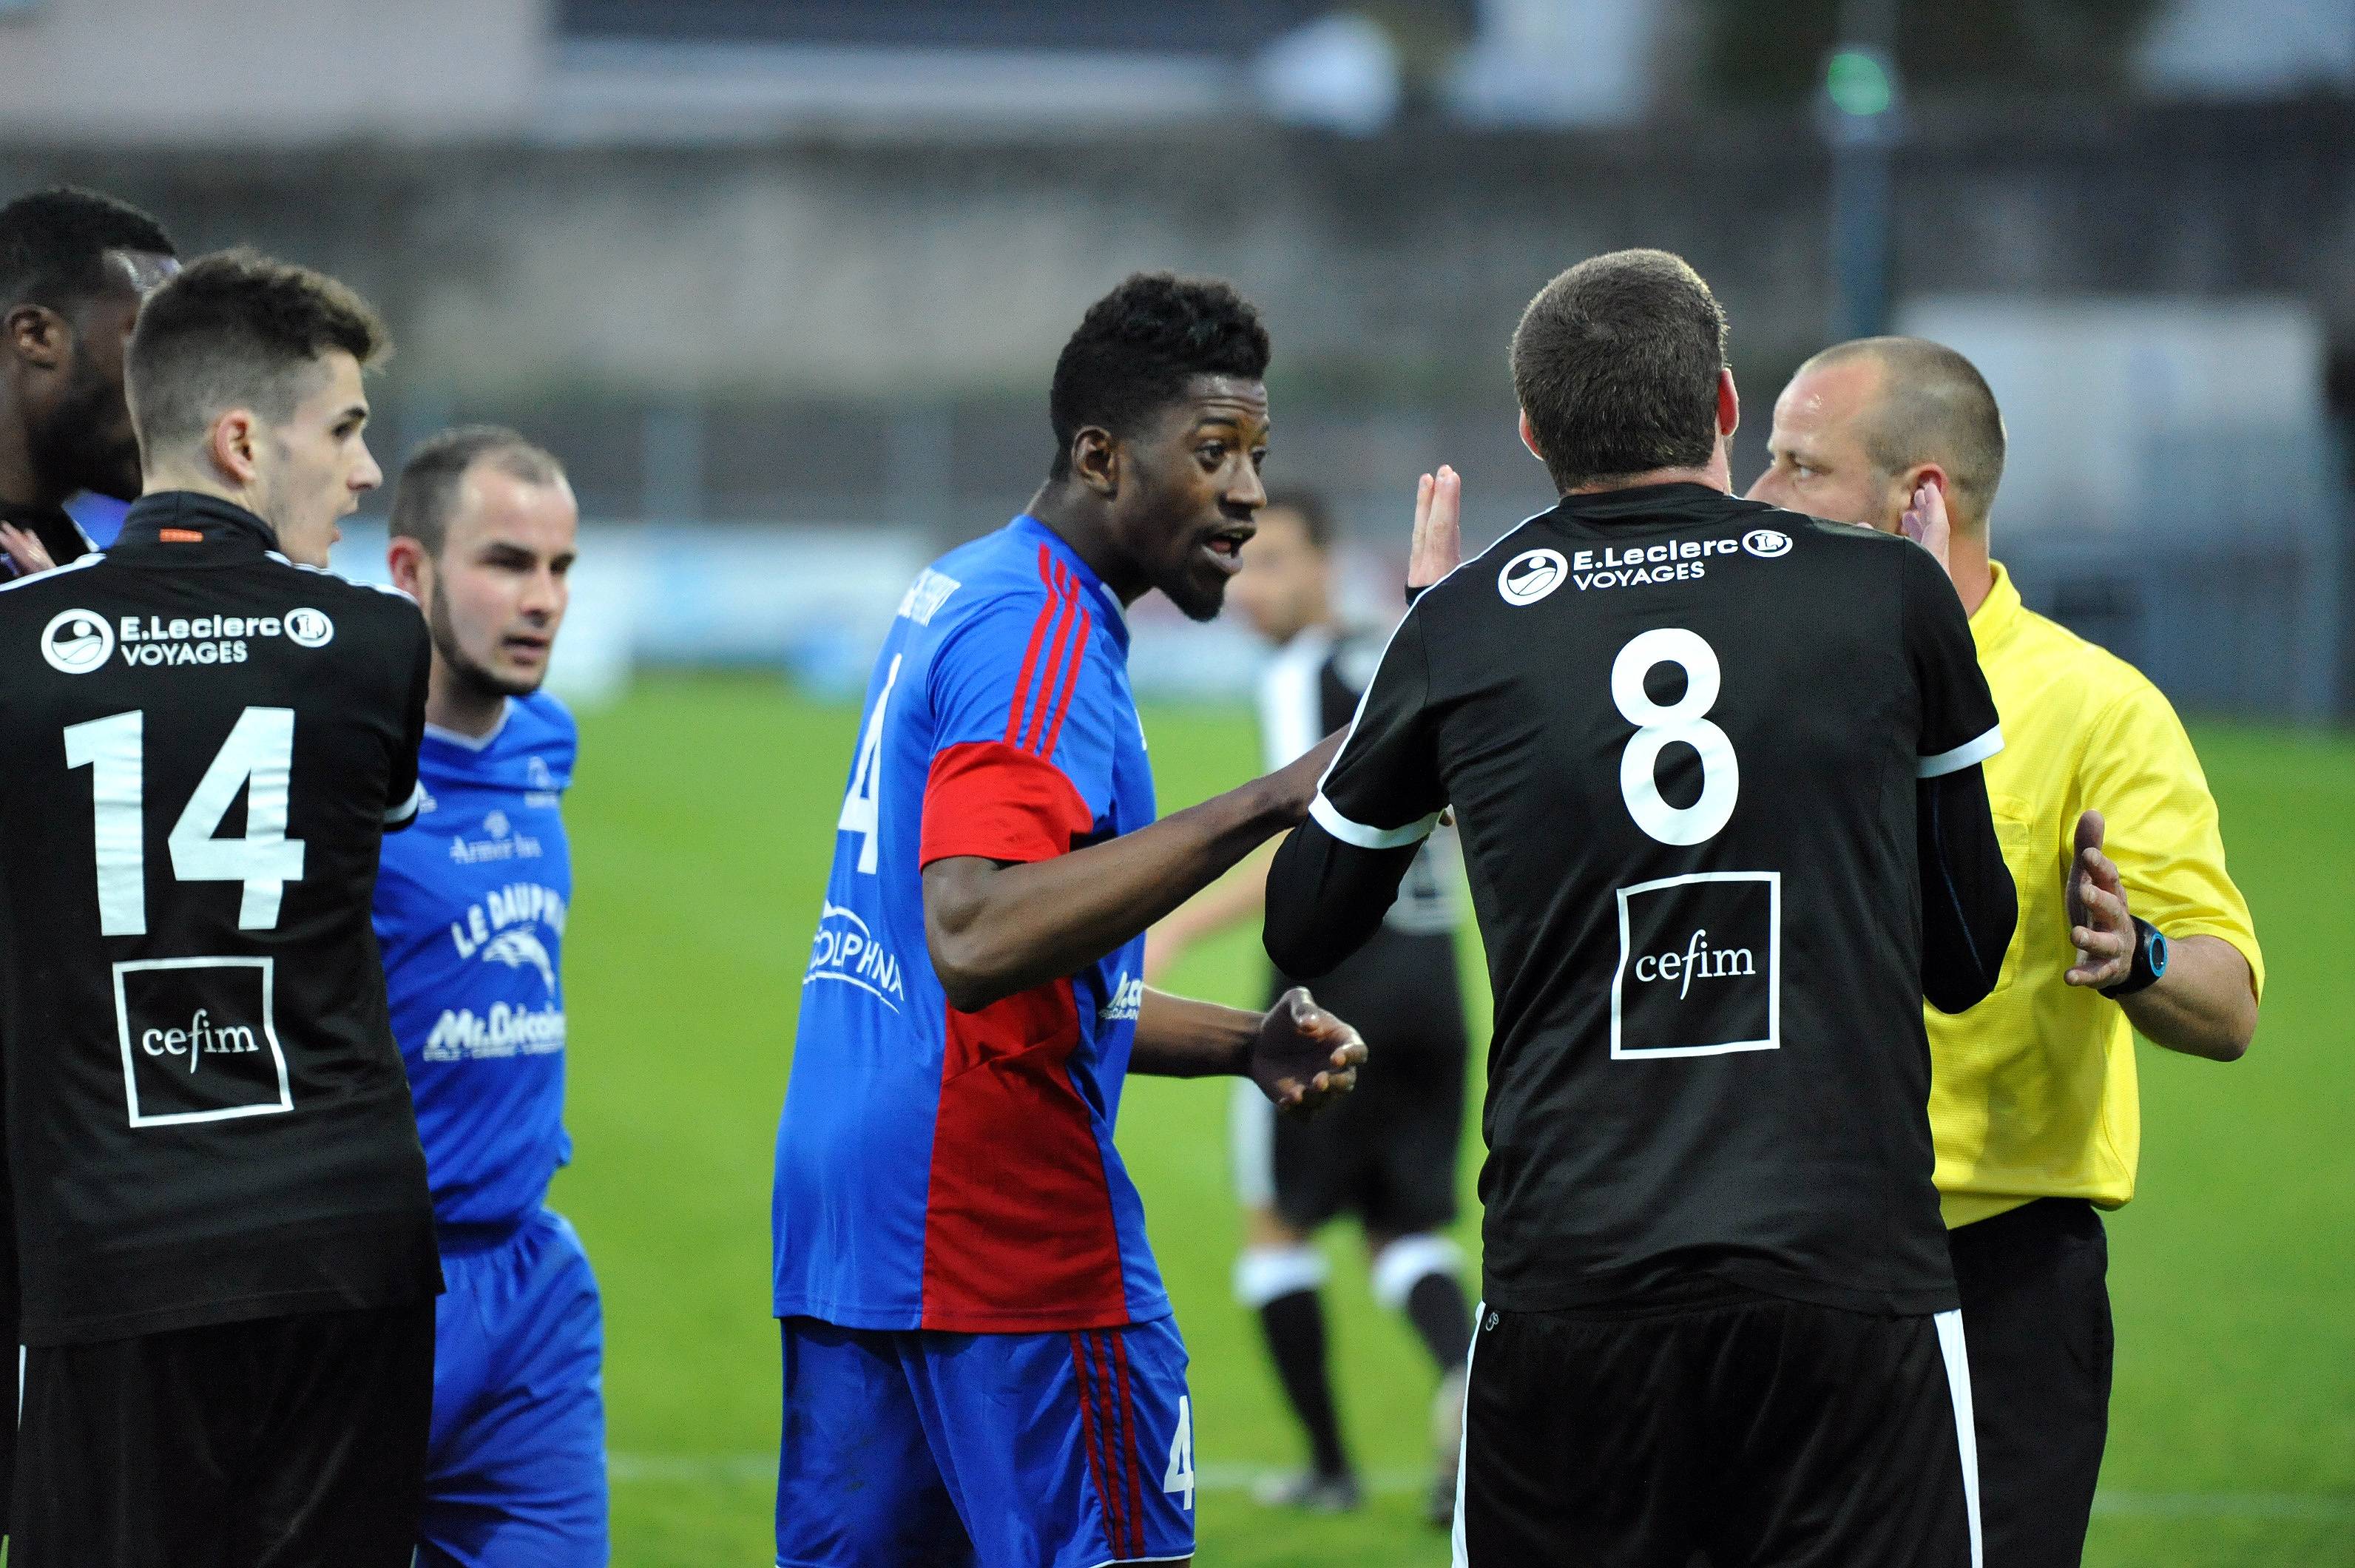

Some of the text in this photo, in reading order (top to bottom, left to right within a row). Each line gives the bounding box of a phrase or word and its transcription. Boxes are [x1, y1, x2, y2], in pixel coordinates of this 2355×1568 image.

[1573, 538, 1738, 570] E.Leclerc
[1573, 561, 1705, 591] VOYAGES
[121, 615, 281, 641] E.Leclerc
[121, 641, 247, 666] VOYAGES
[838, 653, 902, 875] 4
[1611, 628, 1740, 846] 8
[64, 706, 305, 936] 14
[451, 903, 489, 959] LE
[1635, 929, 1756, 1000] cefim
[143, 1008, 259, 1074] cefim
[1163, 1395, 1194, 1510] 4
